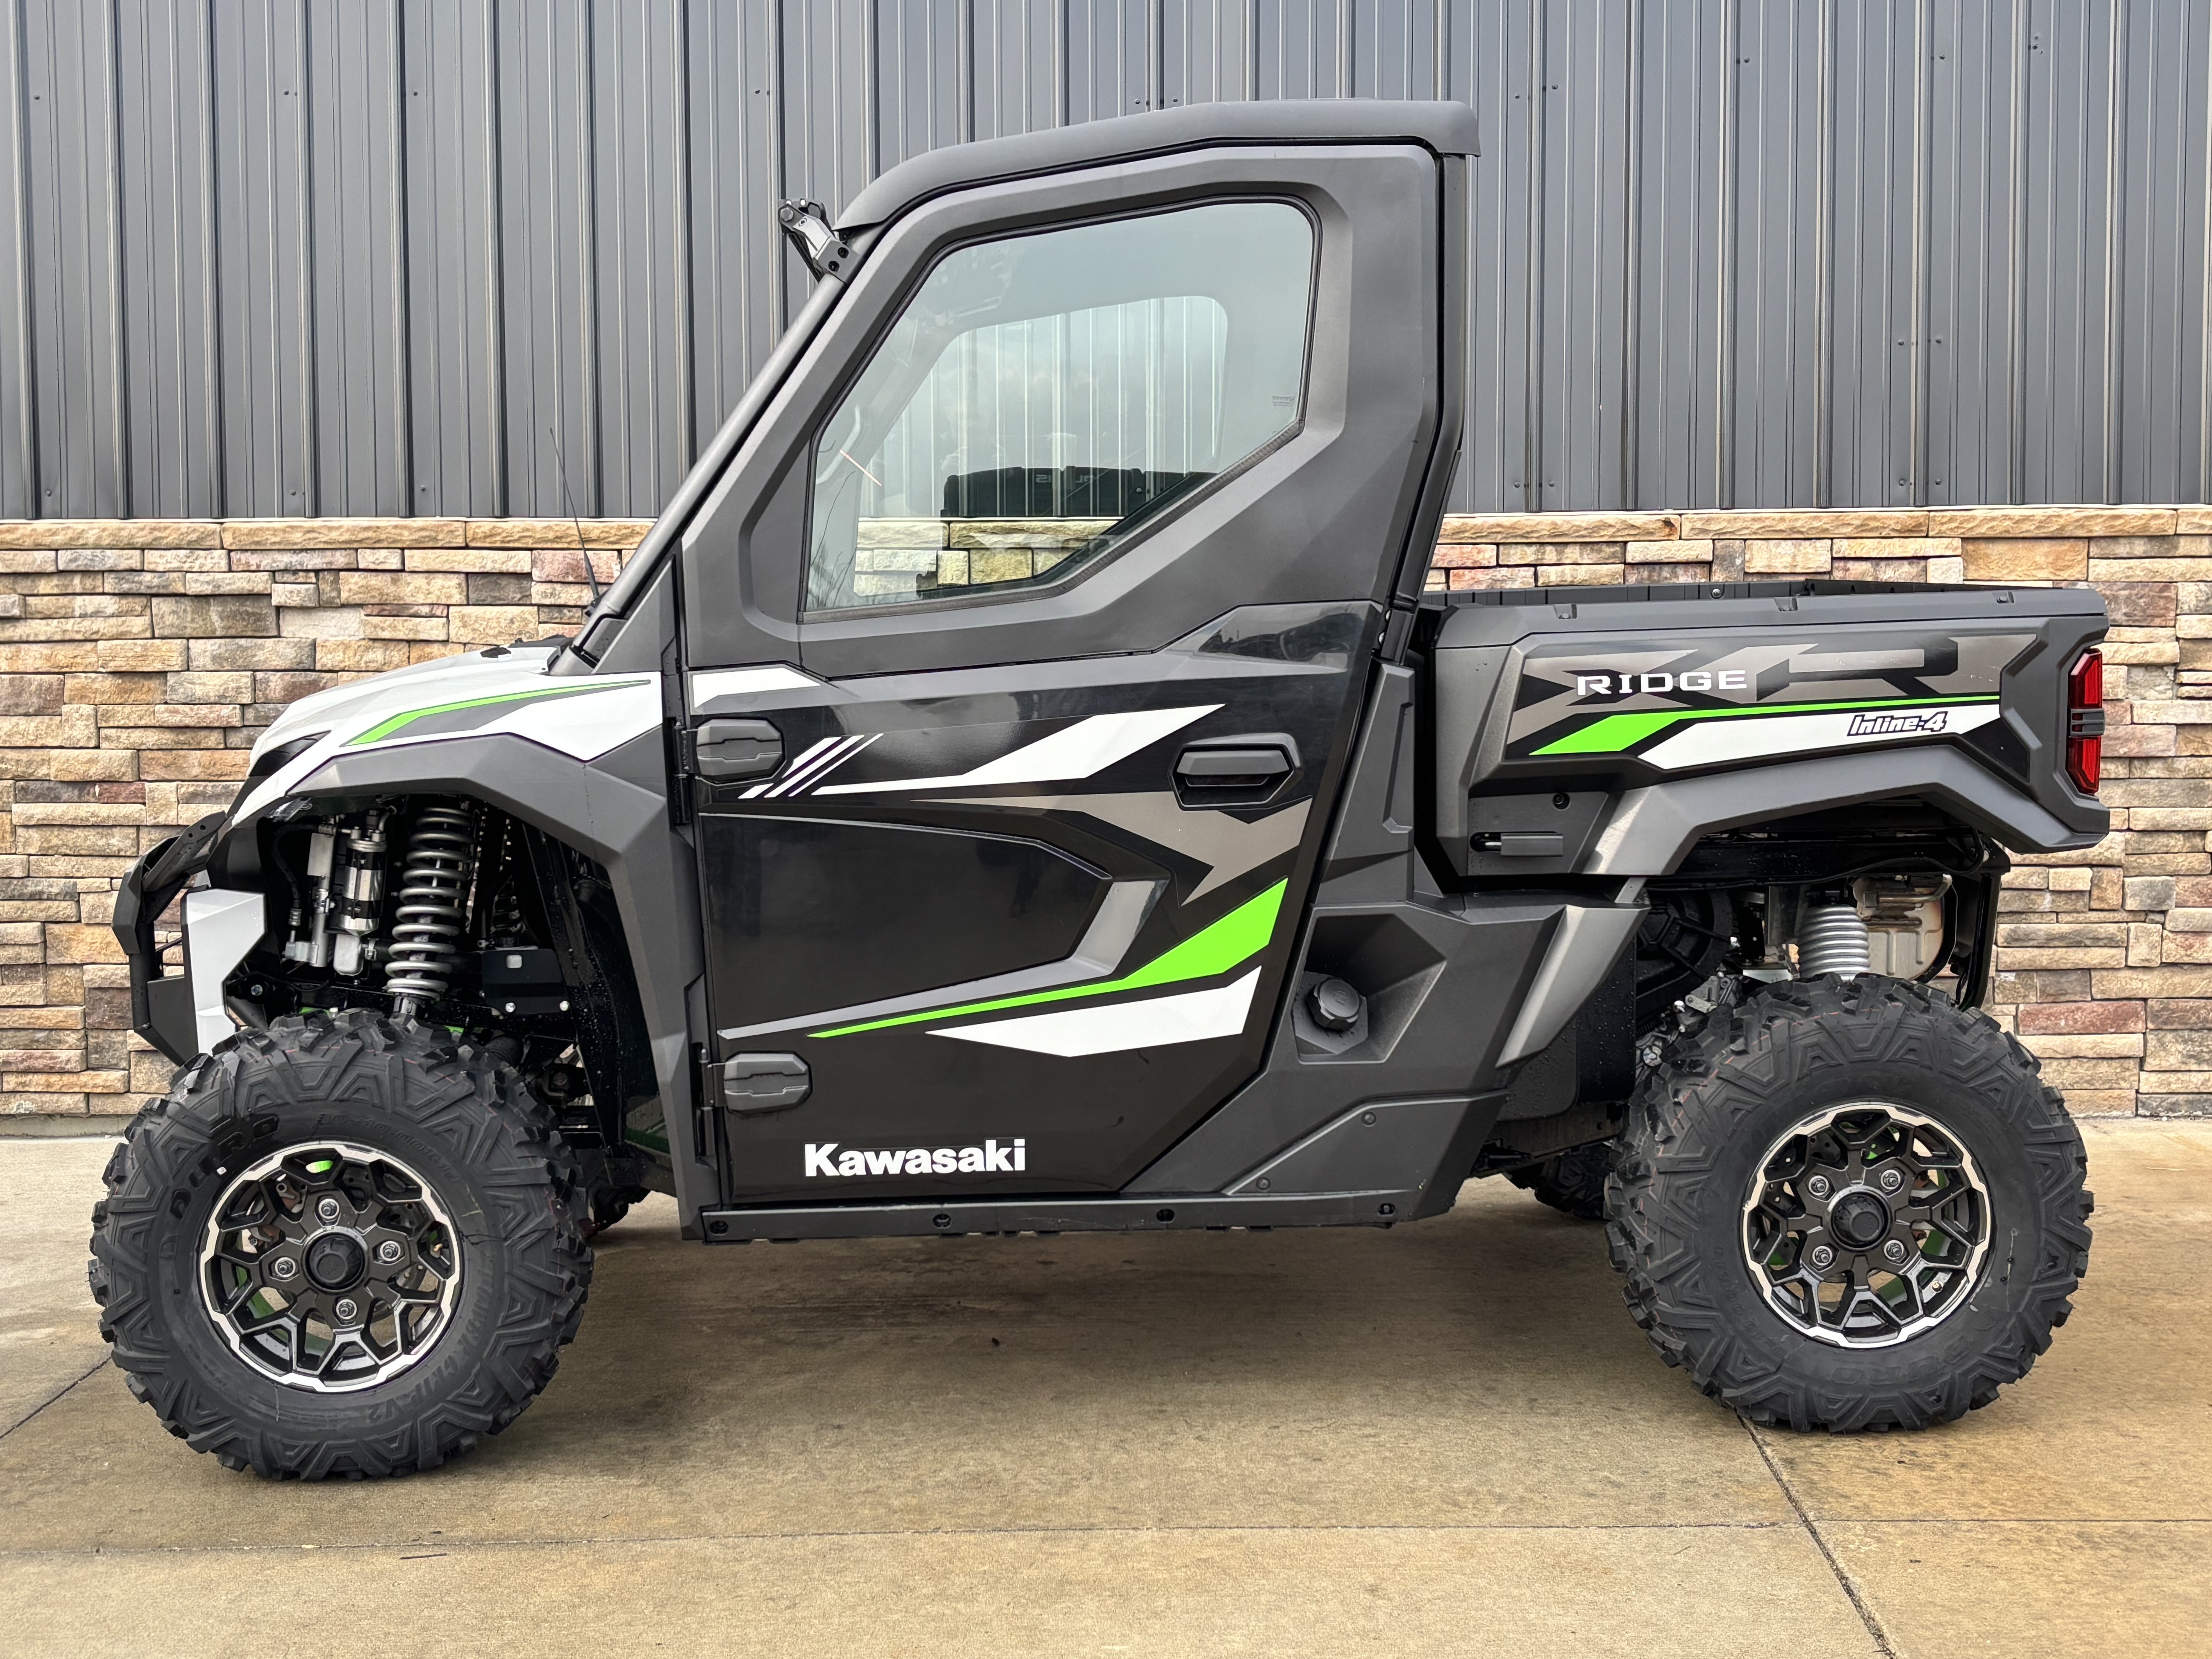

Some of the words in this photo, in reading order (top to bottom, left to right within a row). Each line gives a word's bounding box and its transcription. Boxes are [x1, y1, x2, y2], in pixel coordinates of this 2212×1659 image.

[1577, 670, 1747, 696] RIDGE
[1846, 711, 1948, 736] Inline-4
[170, 1114, 280, 1219] DURO
[805, 1139, 1025, 1176] Kawasaki
[367, 1398, 403, 1424] V2
